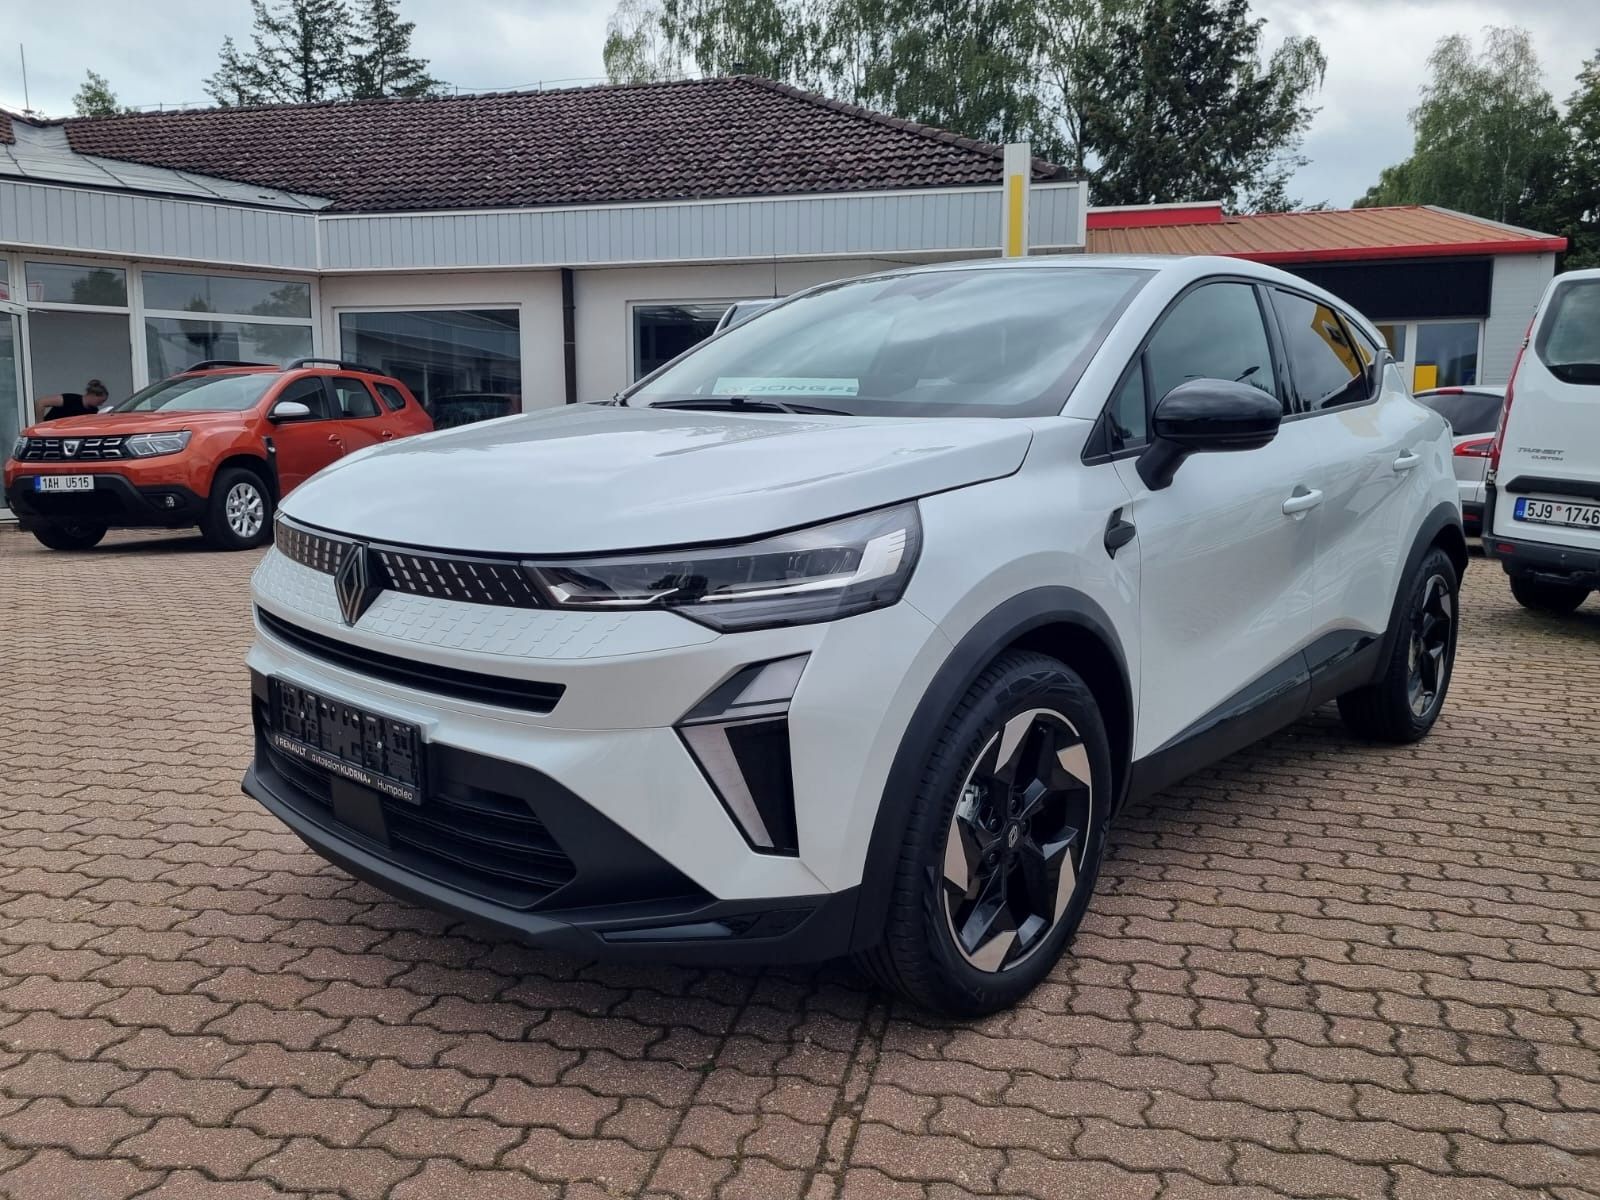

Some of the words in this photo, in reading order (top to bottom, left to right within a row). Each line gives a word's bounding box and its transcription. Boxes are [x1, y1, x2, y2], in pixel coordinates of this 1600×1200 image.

[42, 477, 59, 489] 1AH
[65, 476, 89, 488] U515
[1527, 502, 1553, 519] 5J9
[1565, 506, 1600, 525] 1746
[279, 737, 306, 756] RENAULT
[340, 766, 368, 784] KUDRNA
